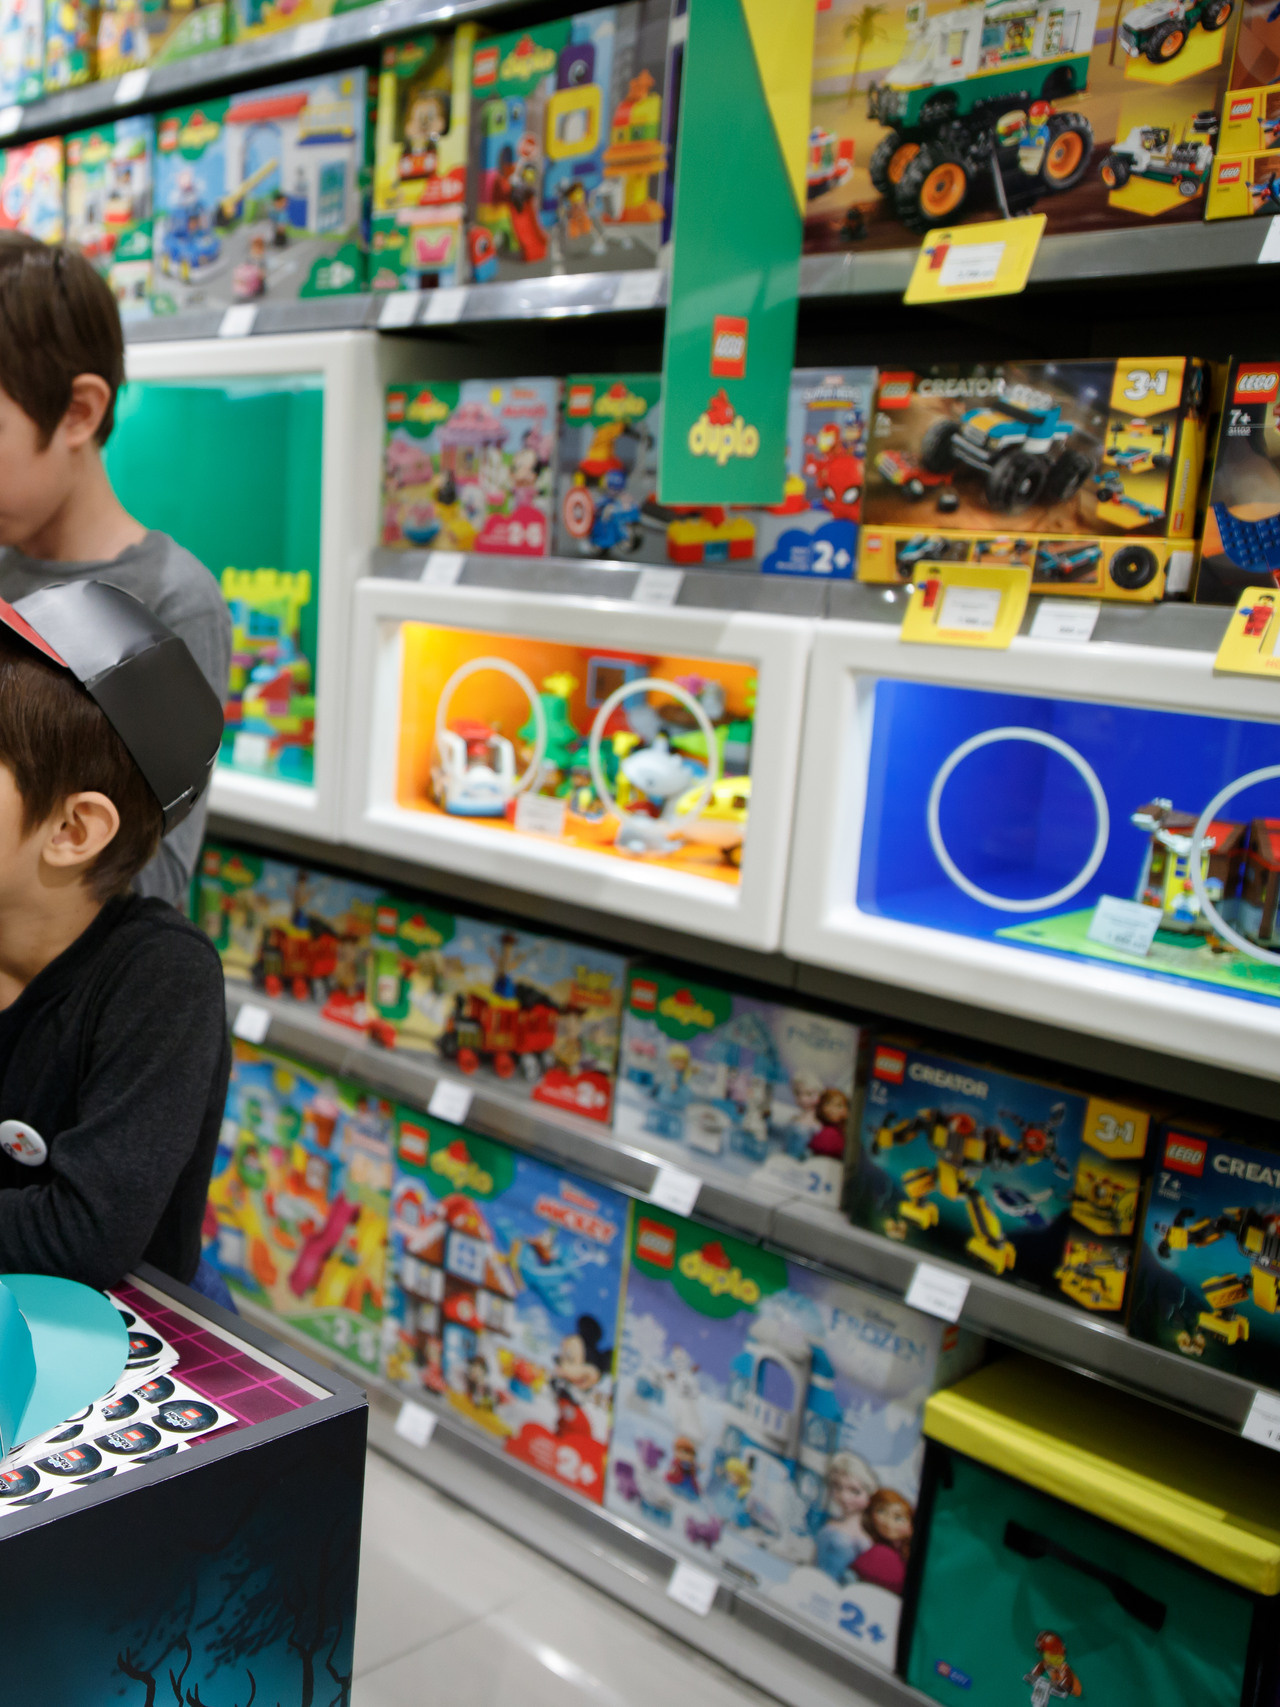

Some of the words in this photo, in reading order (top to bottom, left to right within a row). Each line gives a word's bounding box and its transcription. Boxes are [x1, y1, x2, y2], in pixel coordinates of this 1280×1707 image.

[1231, 104, 1252, 115] LEGO
[1219, 167, 1240, 179] LEGO
[1237, 373, 1278, 392] LEGO
[1230, 409, 1251, 426] 7+
[688, 412, 760, 467] duplo
[909, 1063, 989, 1099] CREATOR
[1167, 1144, 1204, 1165] LEGO
[838, 1601, 886, 1644] 2+
